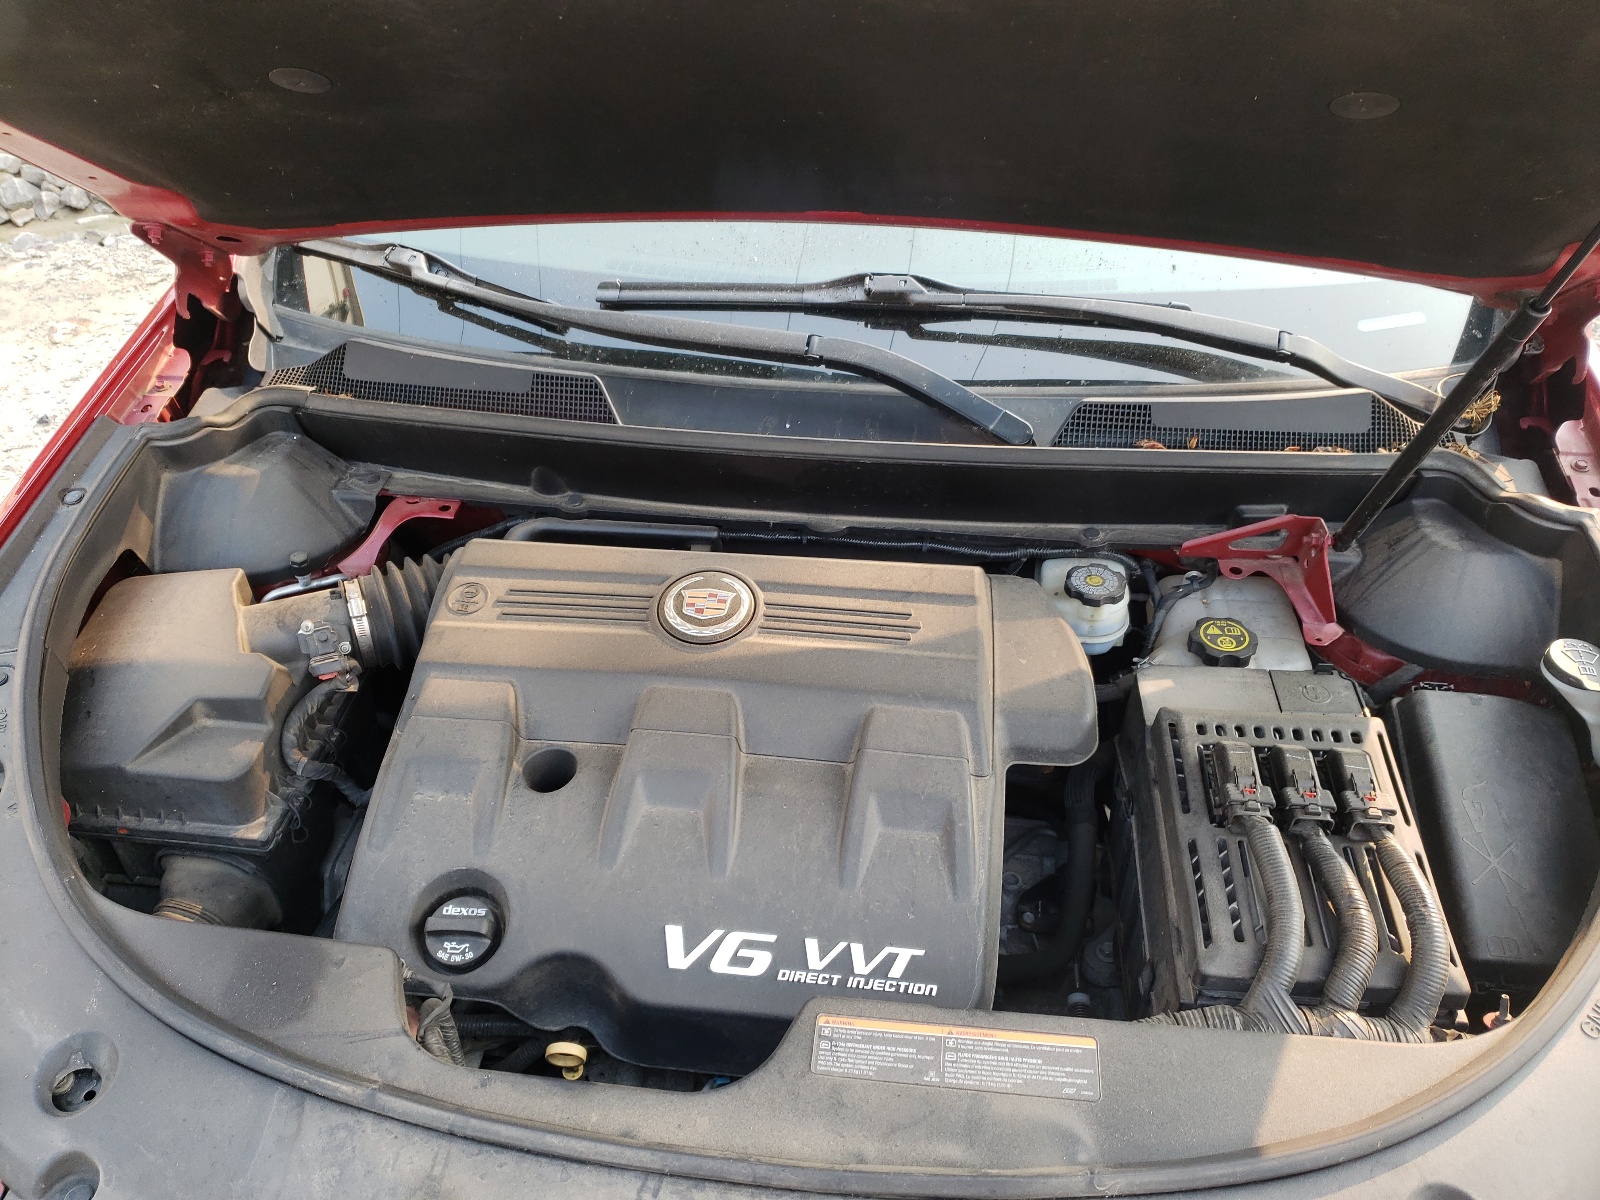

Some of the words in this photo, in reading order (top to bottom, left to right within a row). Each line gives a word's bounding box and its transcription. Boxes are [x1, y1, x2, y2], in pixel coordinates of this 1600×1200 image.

[442, 904, 489, 917] dexos
[436, 950, 450, 961] SAE
[664, 924, 778, 977] V6
[804, 937, 926, 979] VVT
[777, 969, 842, 986] DIRECT
[846, 975, 938, 997] INJECTION
